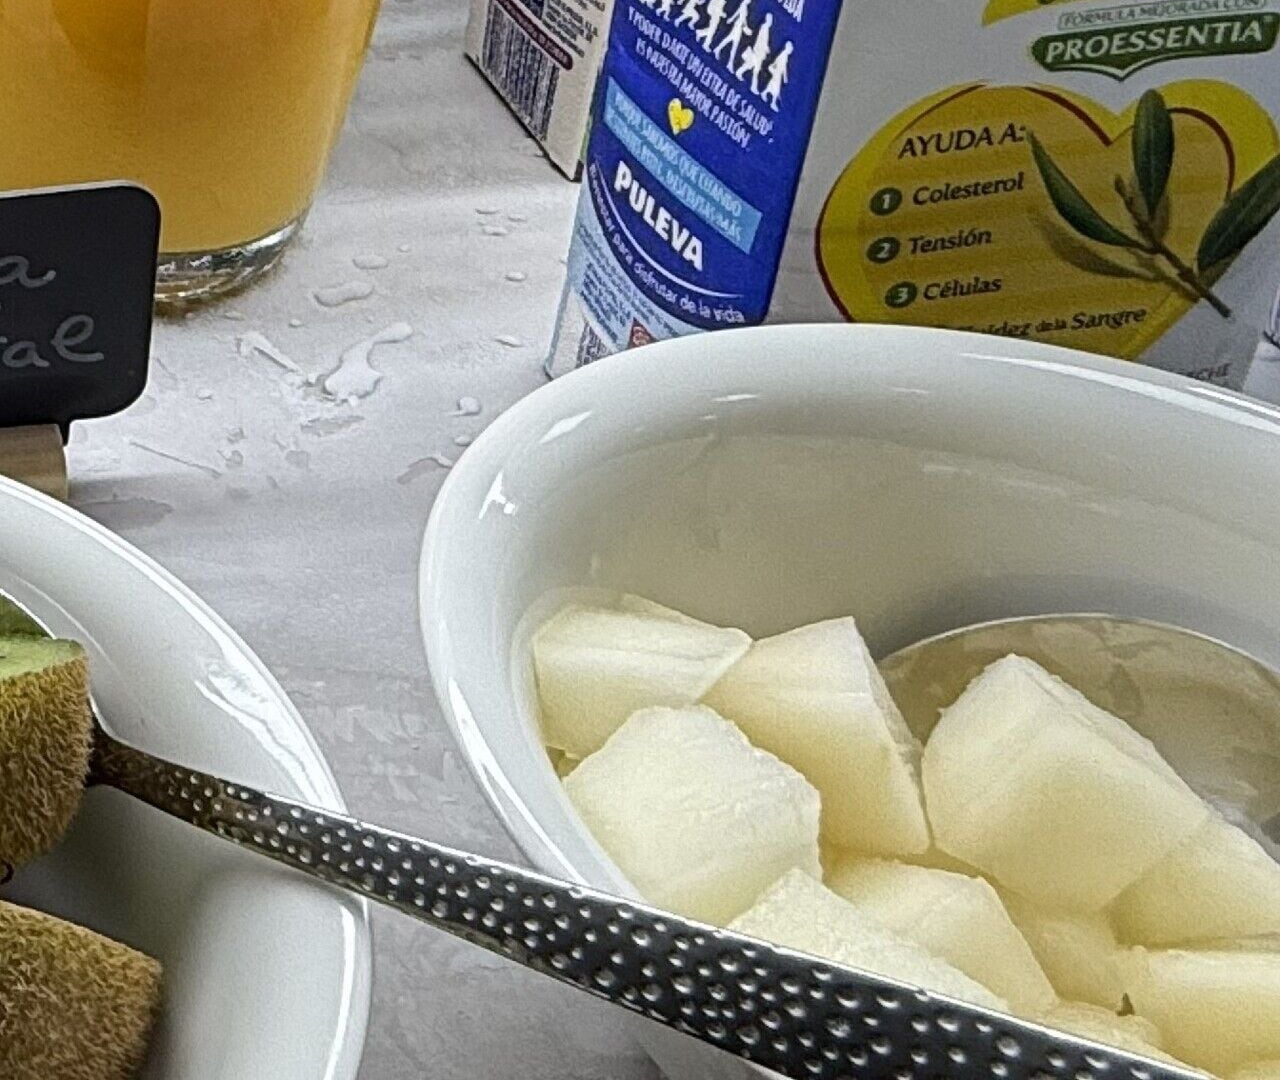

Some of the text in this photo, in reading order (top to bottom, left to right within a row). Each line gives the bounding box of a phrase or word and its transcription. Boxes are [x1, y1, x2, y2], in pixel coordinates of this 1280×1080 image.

[1045, 20, 1263, 63] PROESSENTIA
[897, 125, 995, 160] AYUDA
[912, 172, 1025, 207] Colesterol
[614, 161, 704, 271] PULEVA
[907, 228, 993, 254] Tensión
[923, 275, 1002, 301] Células
[1071, 308, 1148, 331] Sangre
